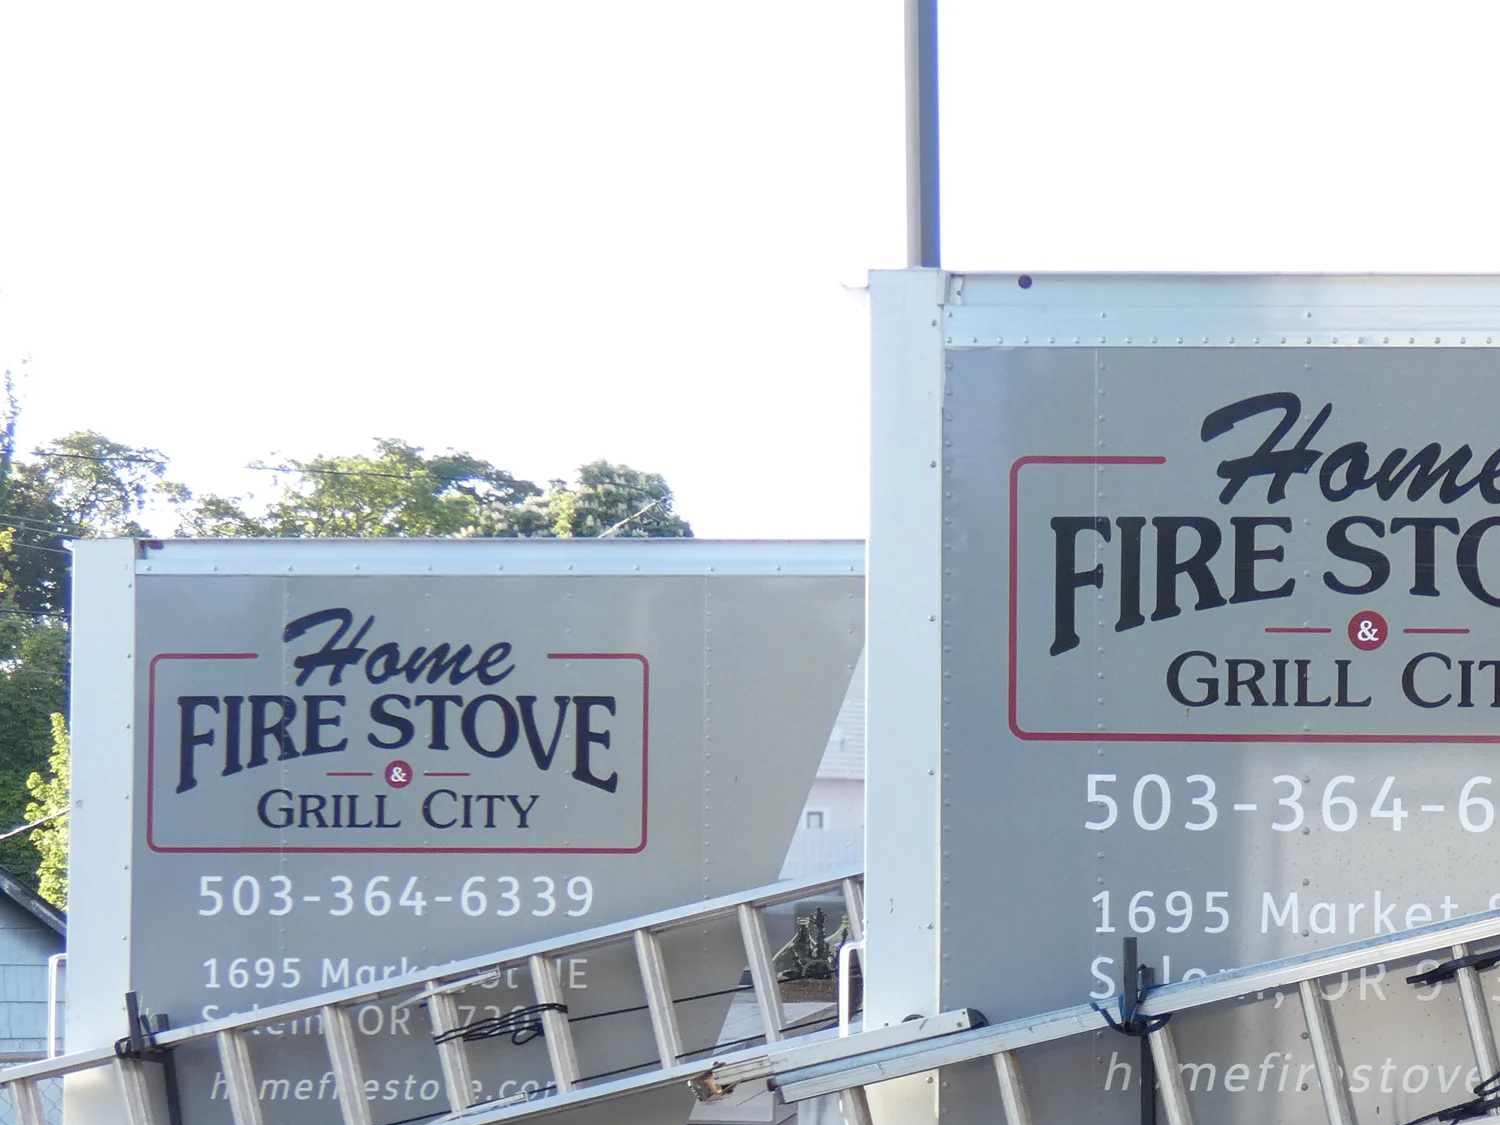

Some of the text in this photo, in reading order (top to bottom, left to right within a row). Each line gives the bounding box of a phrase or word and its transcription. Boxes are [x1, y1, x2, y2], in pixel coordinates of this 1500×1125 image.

[1050, 515, 1297, 657] FIRE
[283, 606, 516, 687] Home
[1356, 620, 1380, 642] &
[1165, 650, 1373, 708] GRILL
[174, 693, 619, 795] FIRE STOVE
[390, 766, 407, 784] &
[255, 788, 540, 830] GRILL CITY
[198, 875, 595, 918] 503-364-6339
[1091, 890, 1230, 934] 1695
[1260, 889, 1459, 935] Market
[203, 957, 301, 990] 1695
[321, 956, 457, 989] Mark
[357, 1004, 411, 1036] OR
